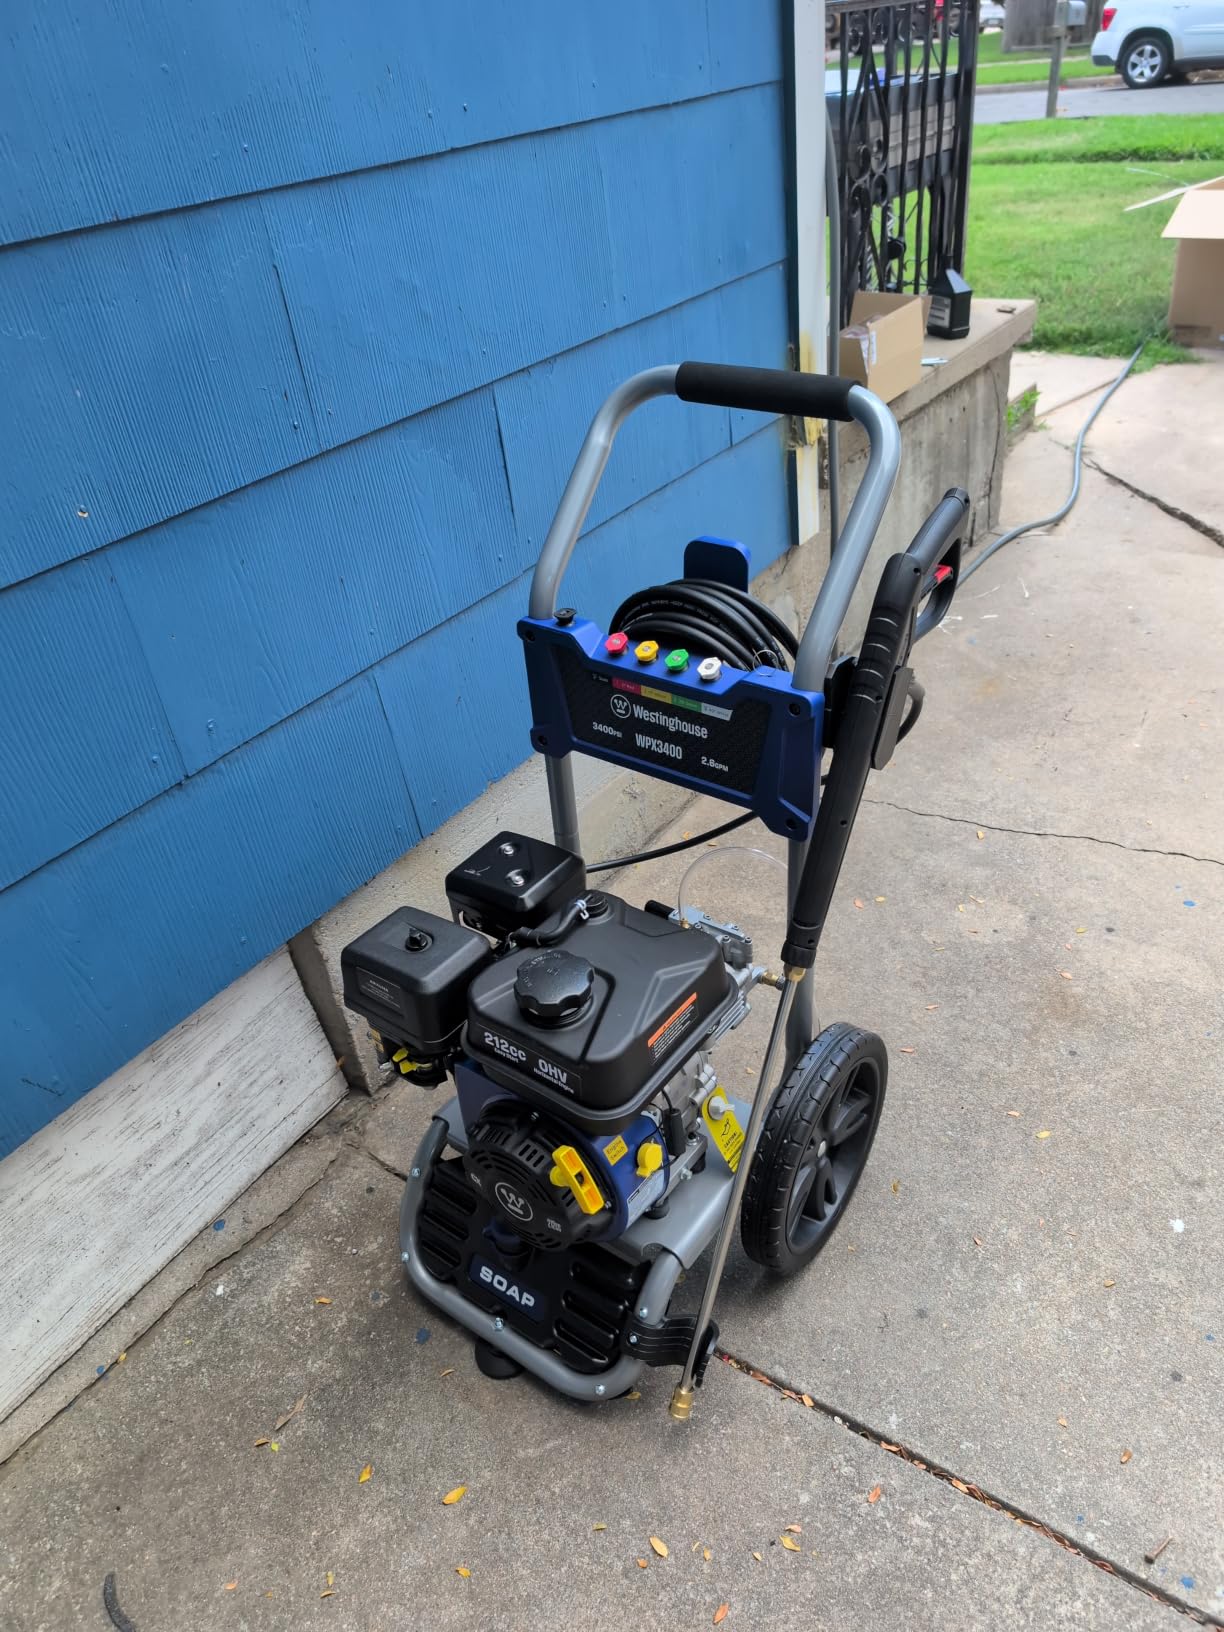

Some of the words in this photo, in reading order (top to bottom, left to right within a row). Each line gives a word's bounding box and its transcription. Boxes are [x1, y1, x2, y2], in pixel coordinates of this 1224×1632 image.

[632, 703, 708, 739] Westinghouse
[635, 733, 683, 760] WPX3400
[484, 1031, 527, 1061] 212cc
[538, 1059, 568, 1084] OHV
[480, 1265, 535, 1307] SOAP
